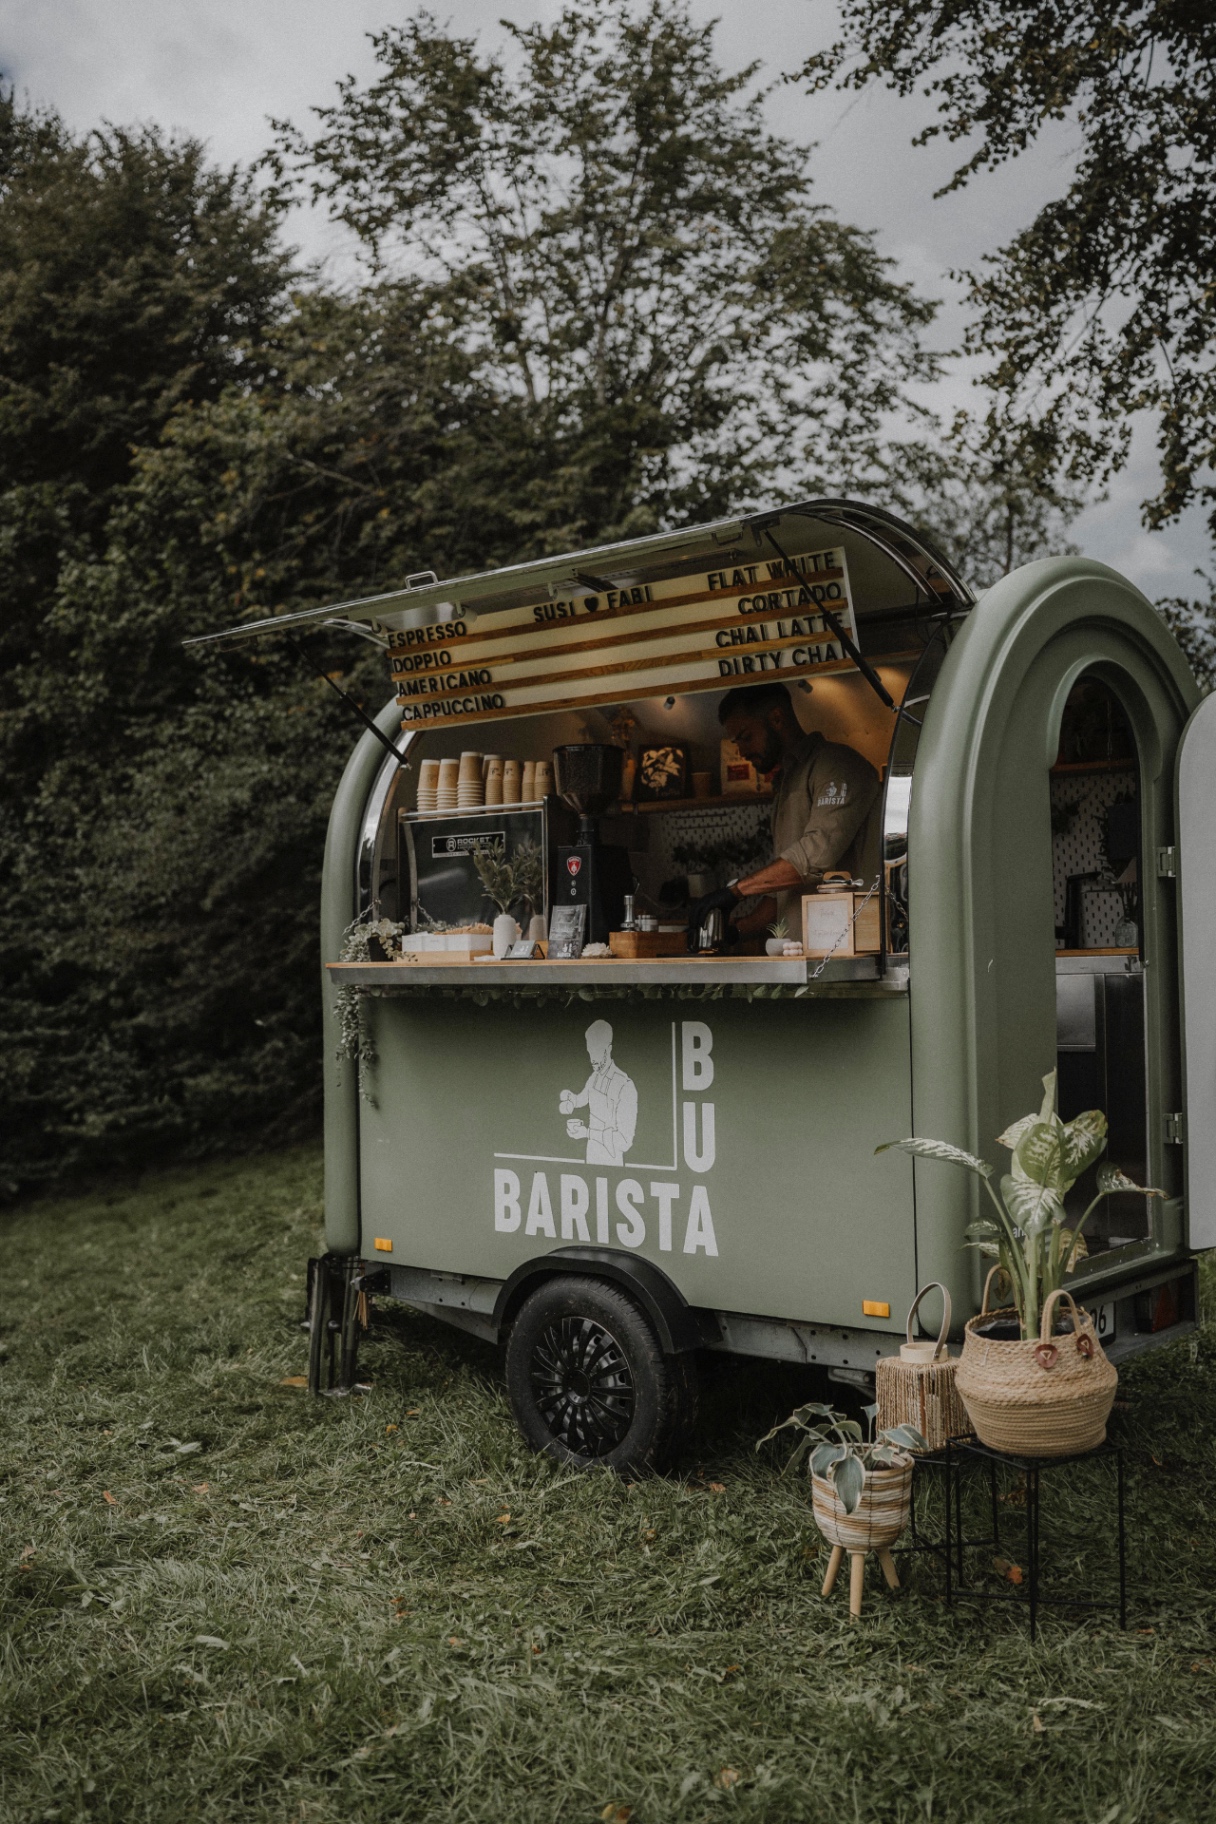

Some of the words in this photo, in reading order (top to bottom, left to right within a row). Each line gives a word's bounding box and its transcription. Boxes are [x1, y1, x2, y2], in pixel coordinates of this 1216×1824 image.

[707, 566, 757, 591] FLAT
[533, 601, 575, 622] SUSI
[606, 586, 651, 610] FABI
[738, 582, 841, 615] CORTADO
[388, 621, 467, 649] ESPRESSO
[716, 623, 766, 648] CHAI
[393, 650, 451, 673] DOPPIO
[718, 651, 782, 677] DIRTY
[399, 669, 492, 696] AMERICANO
[402, 693, 504, 721] CAPPUCCINO
[494, 1168, 719, 1257] BARISTA
